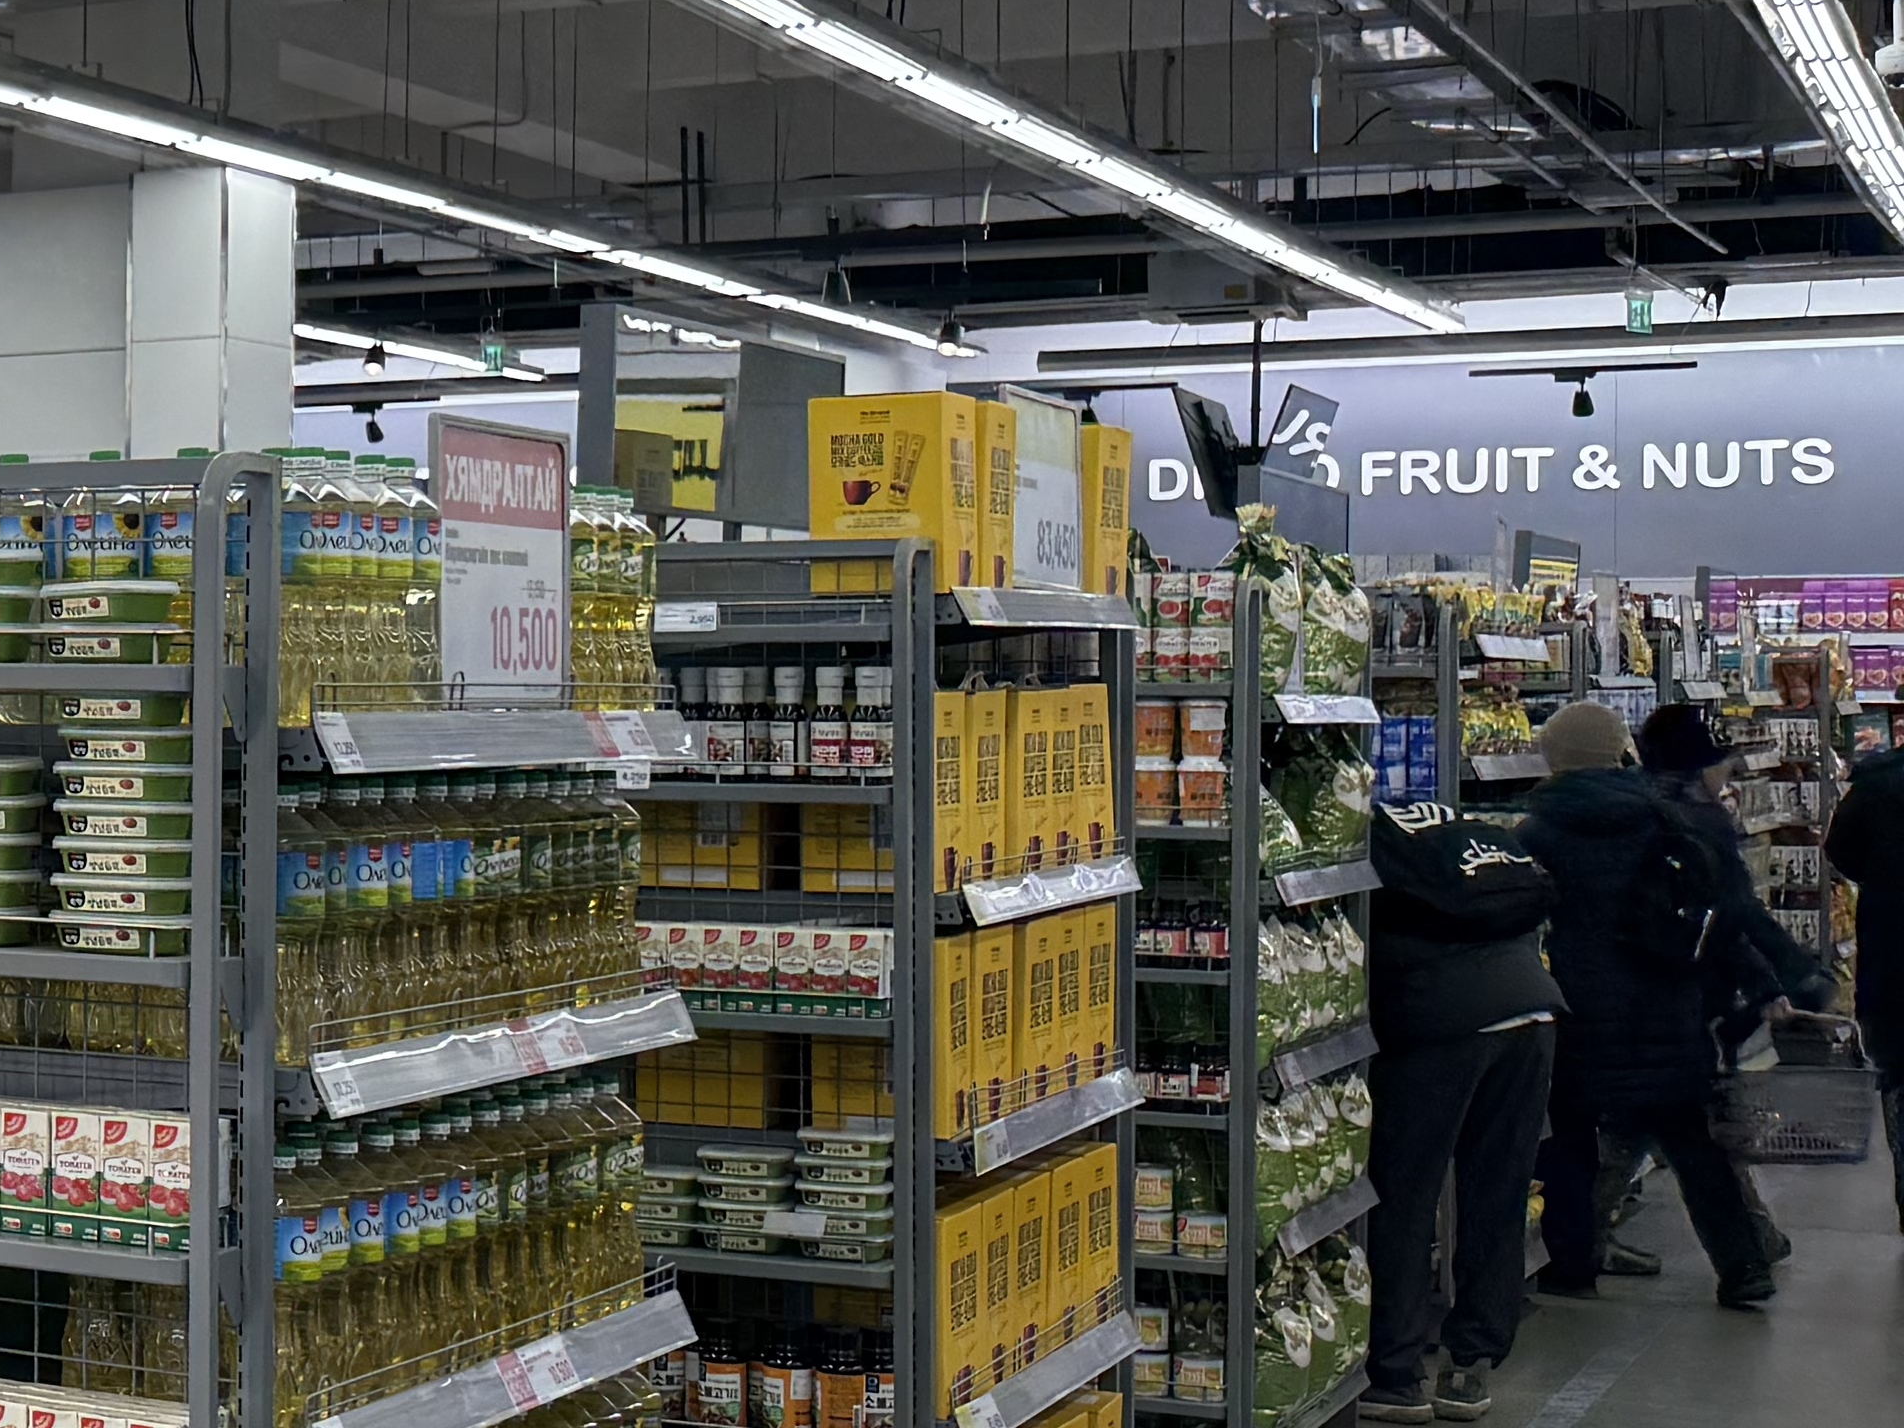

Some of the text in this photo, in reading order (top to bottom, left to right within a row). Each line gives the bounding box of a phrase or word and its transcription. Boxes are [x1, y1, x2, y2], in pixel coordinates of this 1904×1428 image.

[862, 432, 885, 445] GOLD
[1360, 446, 1555, 496] FRUIT
[1571, 443, 1622, 492] &
[1642, 437, 1837, 490] NUTS
[444, 452, 558, 514] ХЯМДРАЛТАЙ
[1035, 518, 1077, 571] 83,450
[490, 605, 559, 676] 10,500
